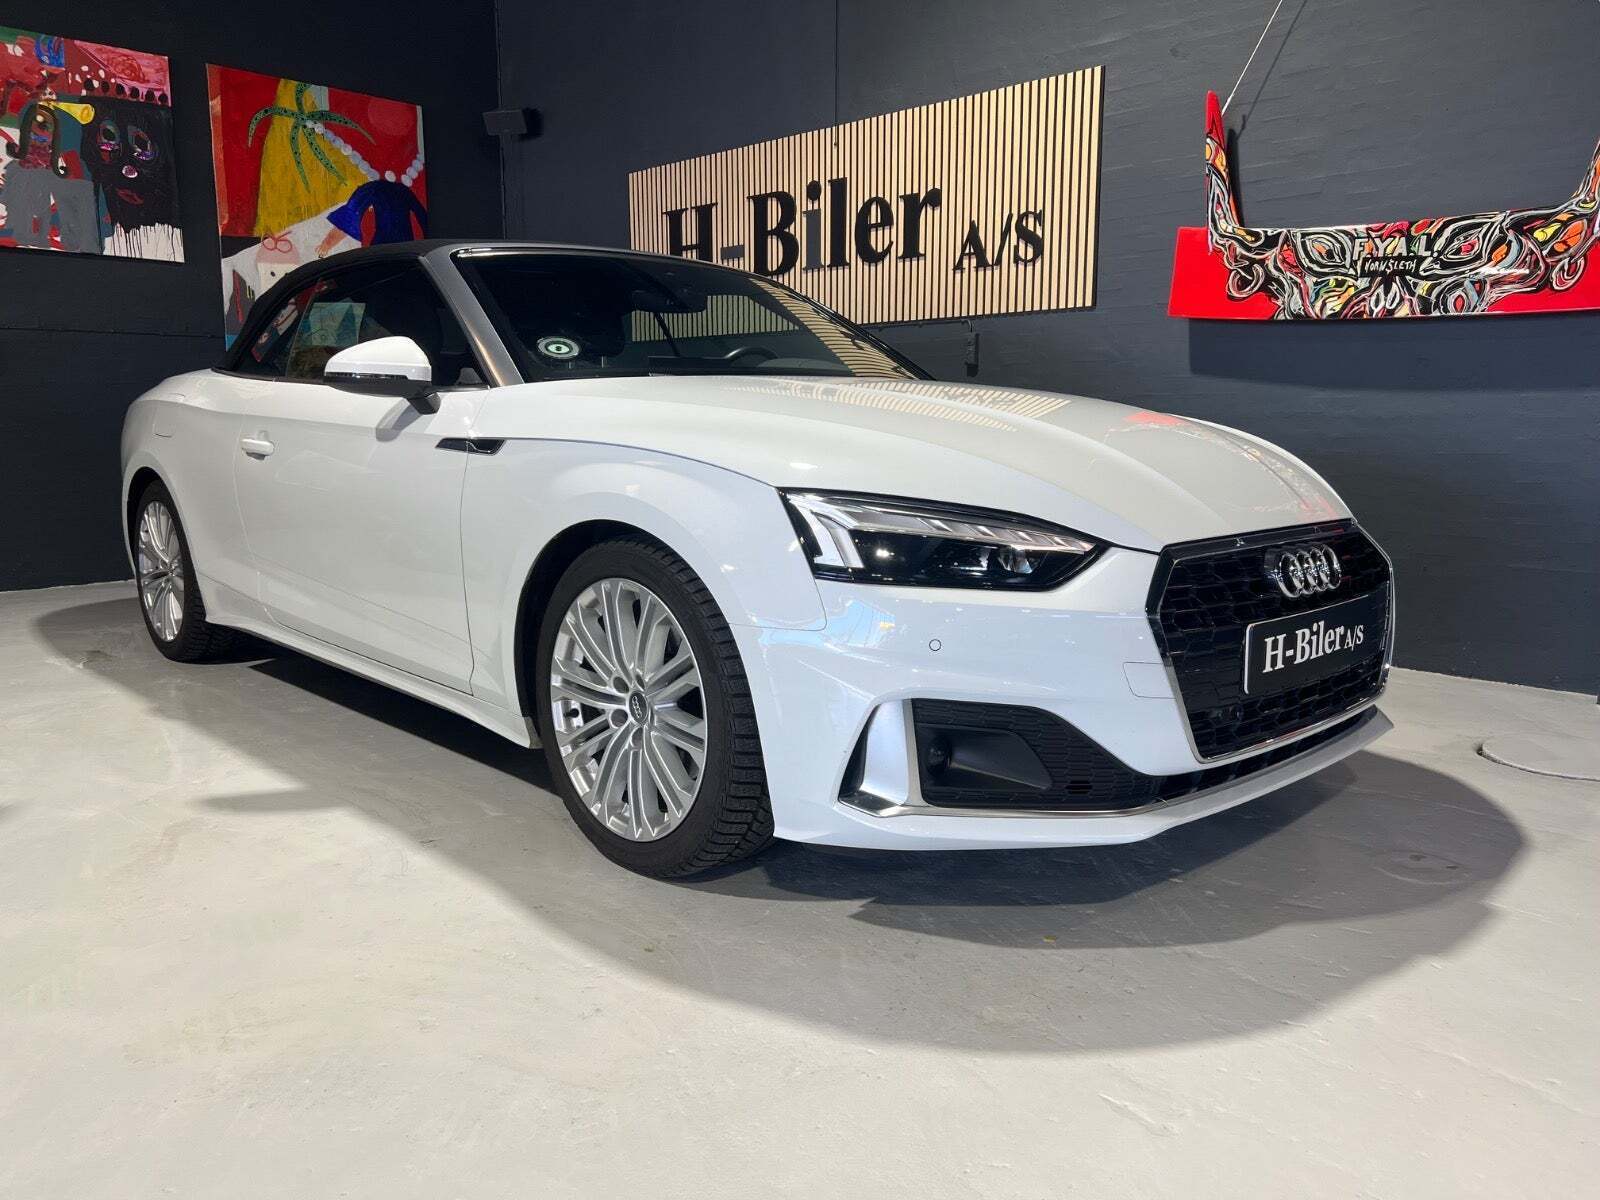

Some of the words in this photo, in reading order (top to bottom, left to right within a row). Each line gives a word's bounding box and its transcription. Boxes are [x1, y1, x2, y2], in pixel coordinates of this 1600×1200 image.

[662, 177, 943, 277] H-Biler
[952, 209, 1044, 271] A/S
[1262, 620, 1345, 673] H-Biler
[1343, 624, 1364, 651] A/S
